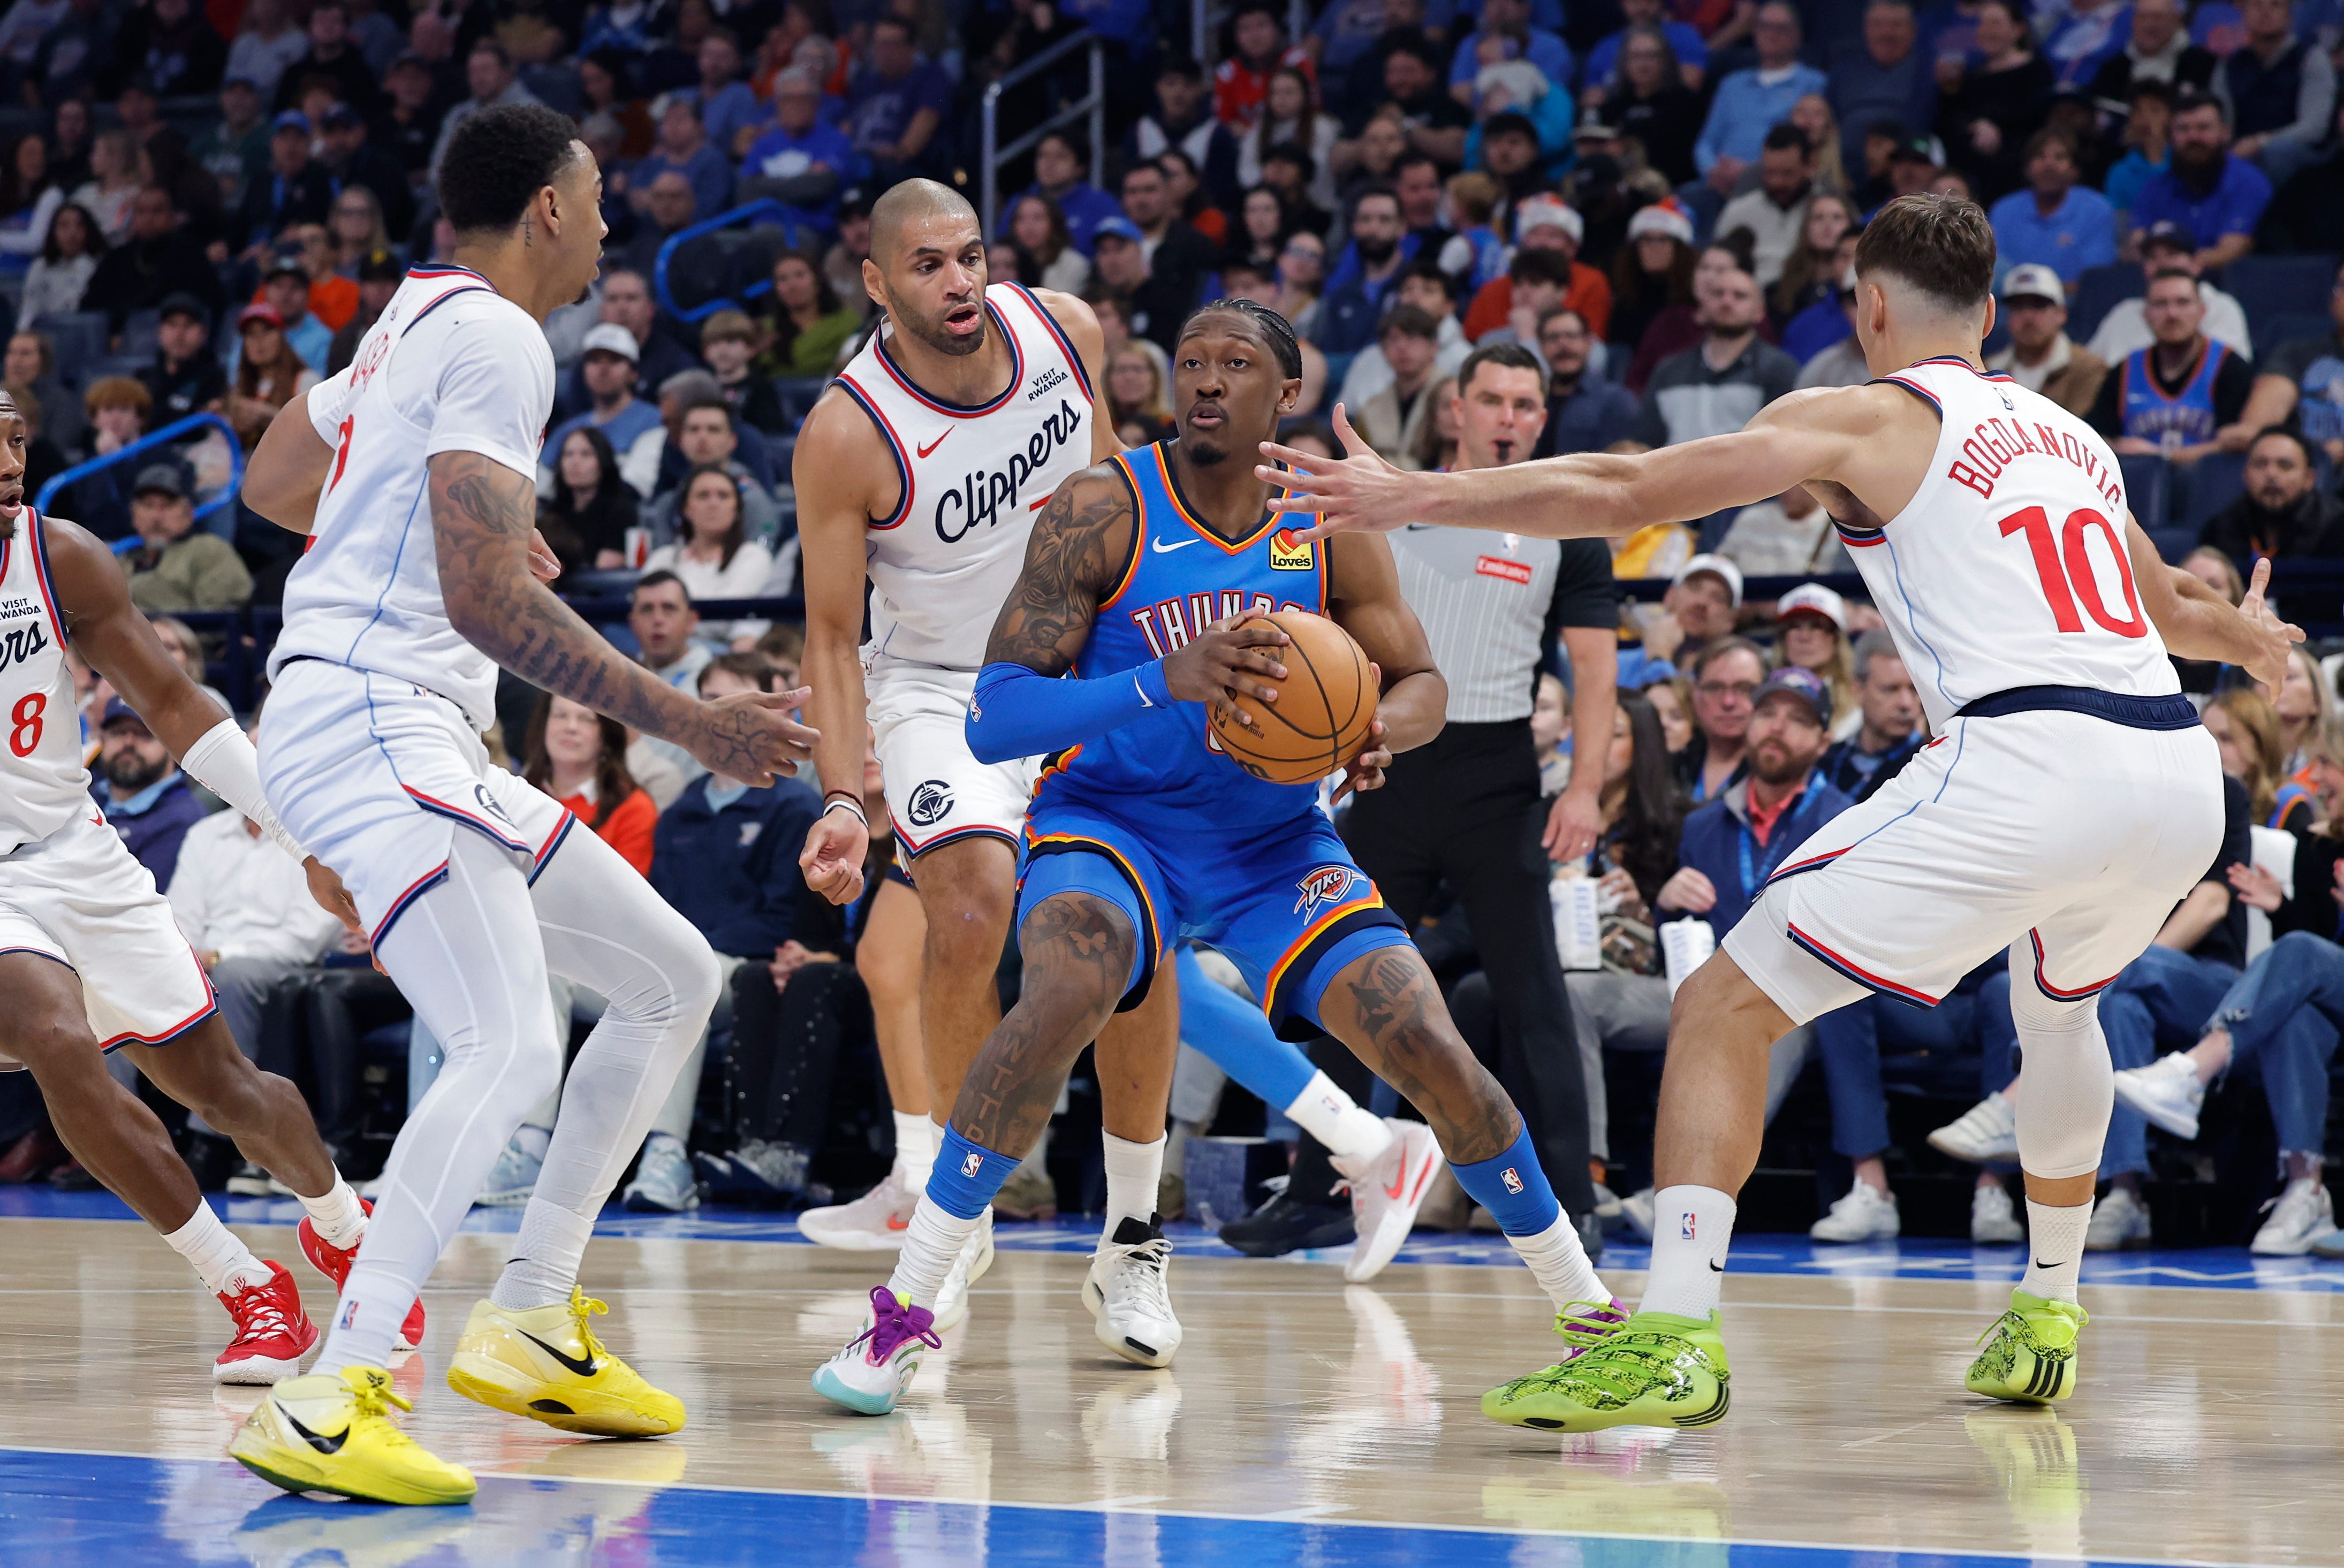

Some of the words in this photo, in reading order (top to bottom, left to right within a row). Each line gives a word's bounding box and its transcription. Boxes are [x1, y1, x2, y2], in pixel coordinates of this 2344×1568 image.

[1028, 371, 1068, 401] RWANDA
[1032, 368, 1056, 386] VISIT
[935, 399, 1081, 543] Clippers
[1998, 506, 2148, 638] 10
[0, 605, 41, 620] WANDA
[2, 598, 28, 610] VISIT
[10, 692, 47, 758] 8
[1308, 870, 1341, 905] OKC
